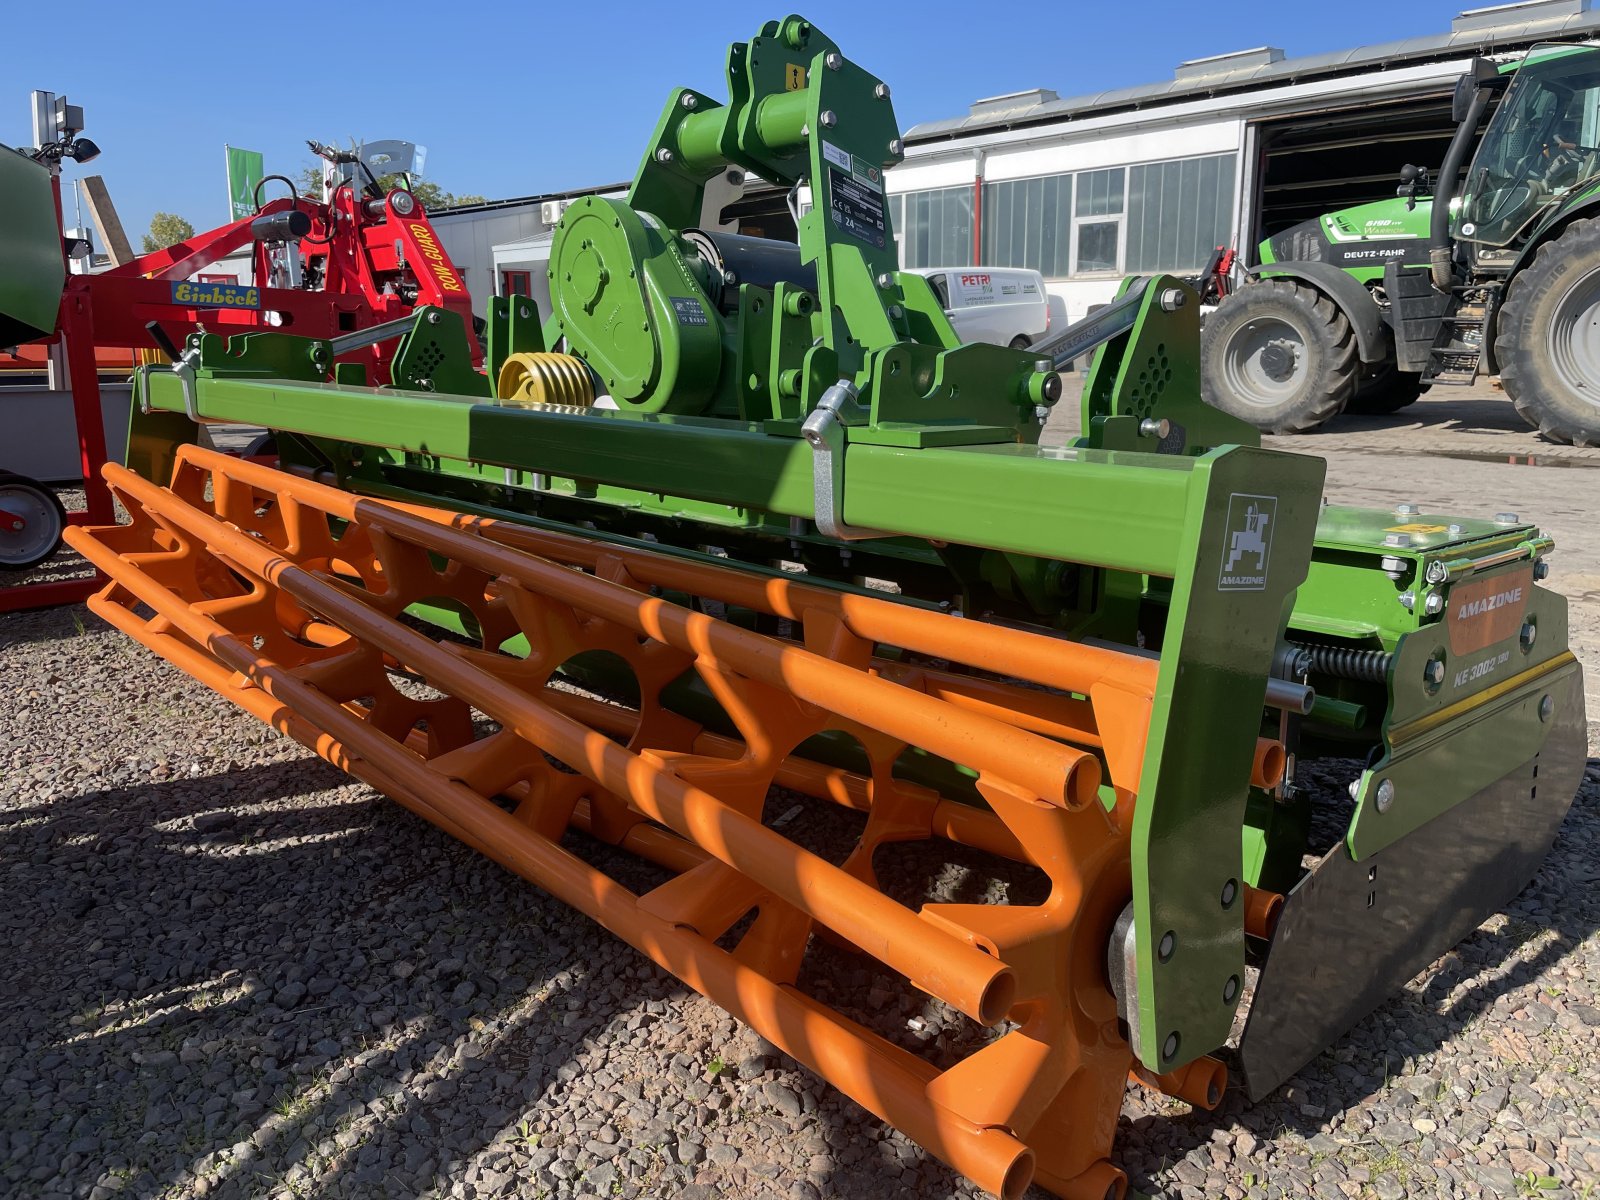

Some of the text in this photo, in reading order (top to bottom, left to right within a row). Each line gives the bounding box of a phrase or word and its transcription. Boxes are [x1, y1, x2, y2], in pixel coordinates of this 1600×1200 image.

[845, 216, 855, 229] 24
[410, 224, 461, 291] ROW-GUARD
[961, 275, 991, 286] PETRI
[175, 284, 258, 306] Einböck
[1221, 576, 1264, 585] AMAZONE
[1458, 588, 1522, 621] AMAZONE
[1454, 668, 1469, 688] KE
[1469, 657, 1496, 680] 3002
